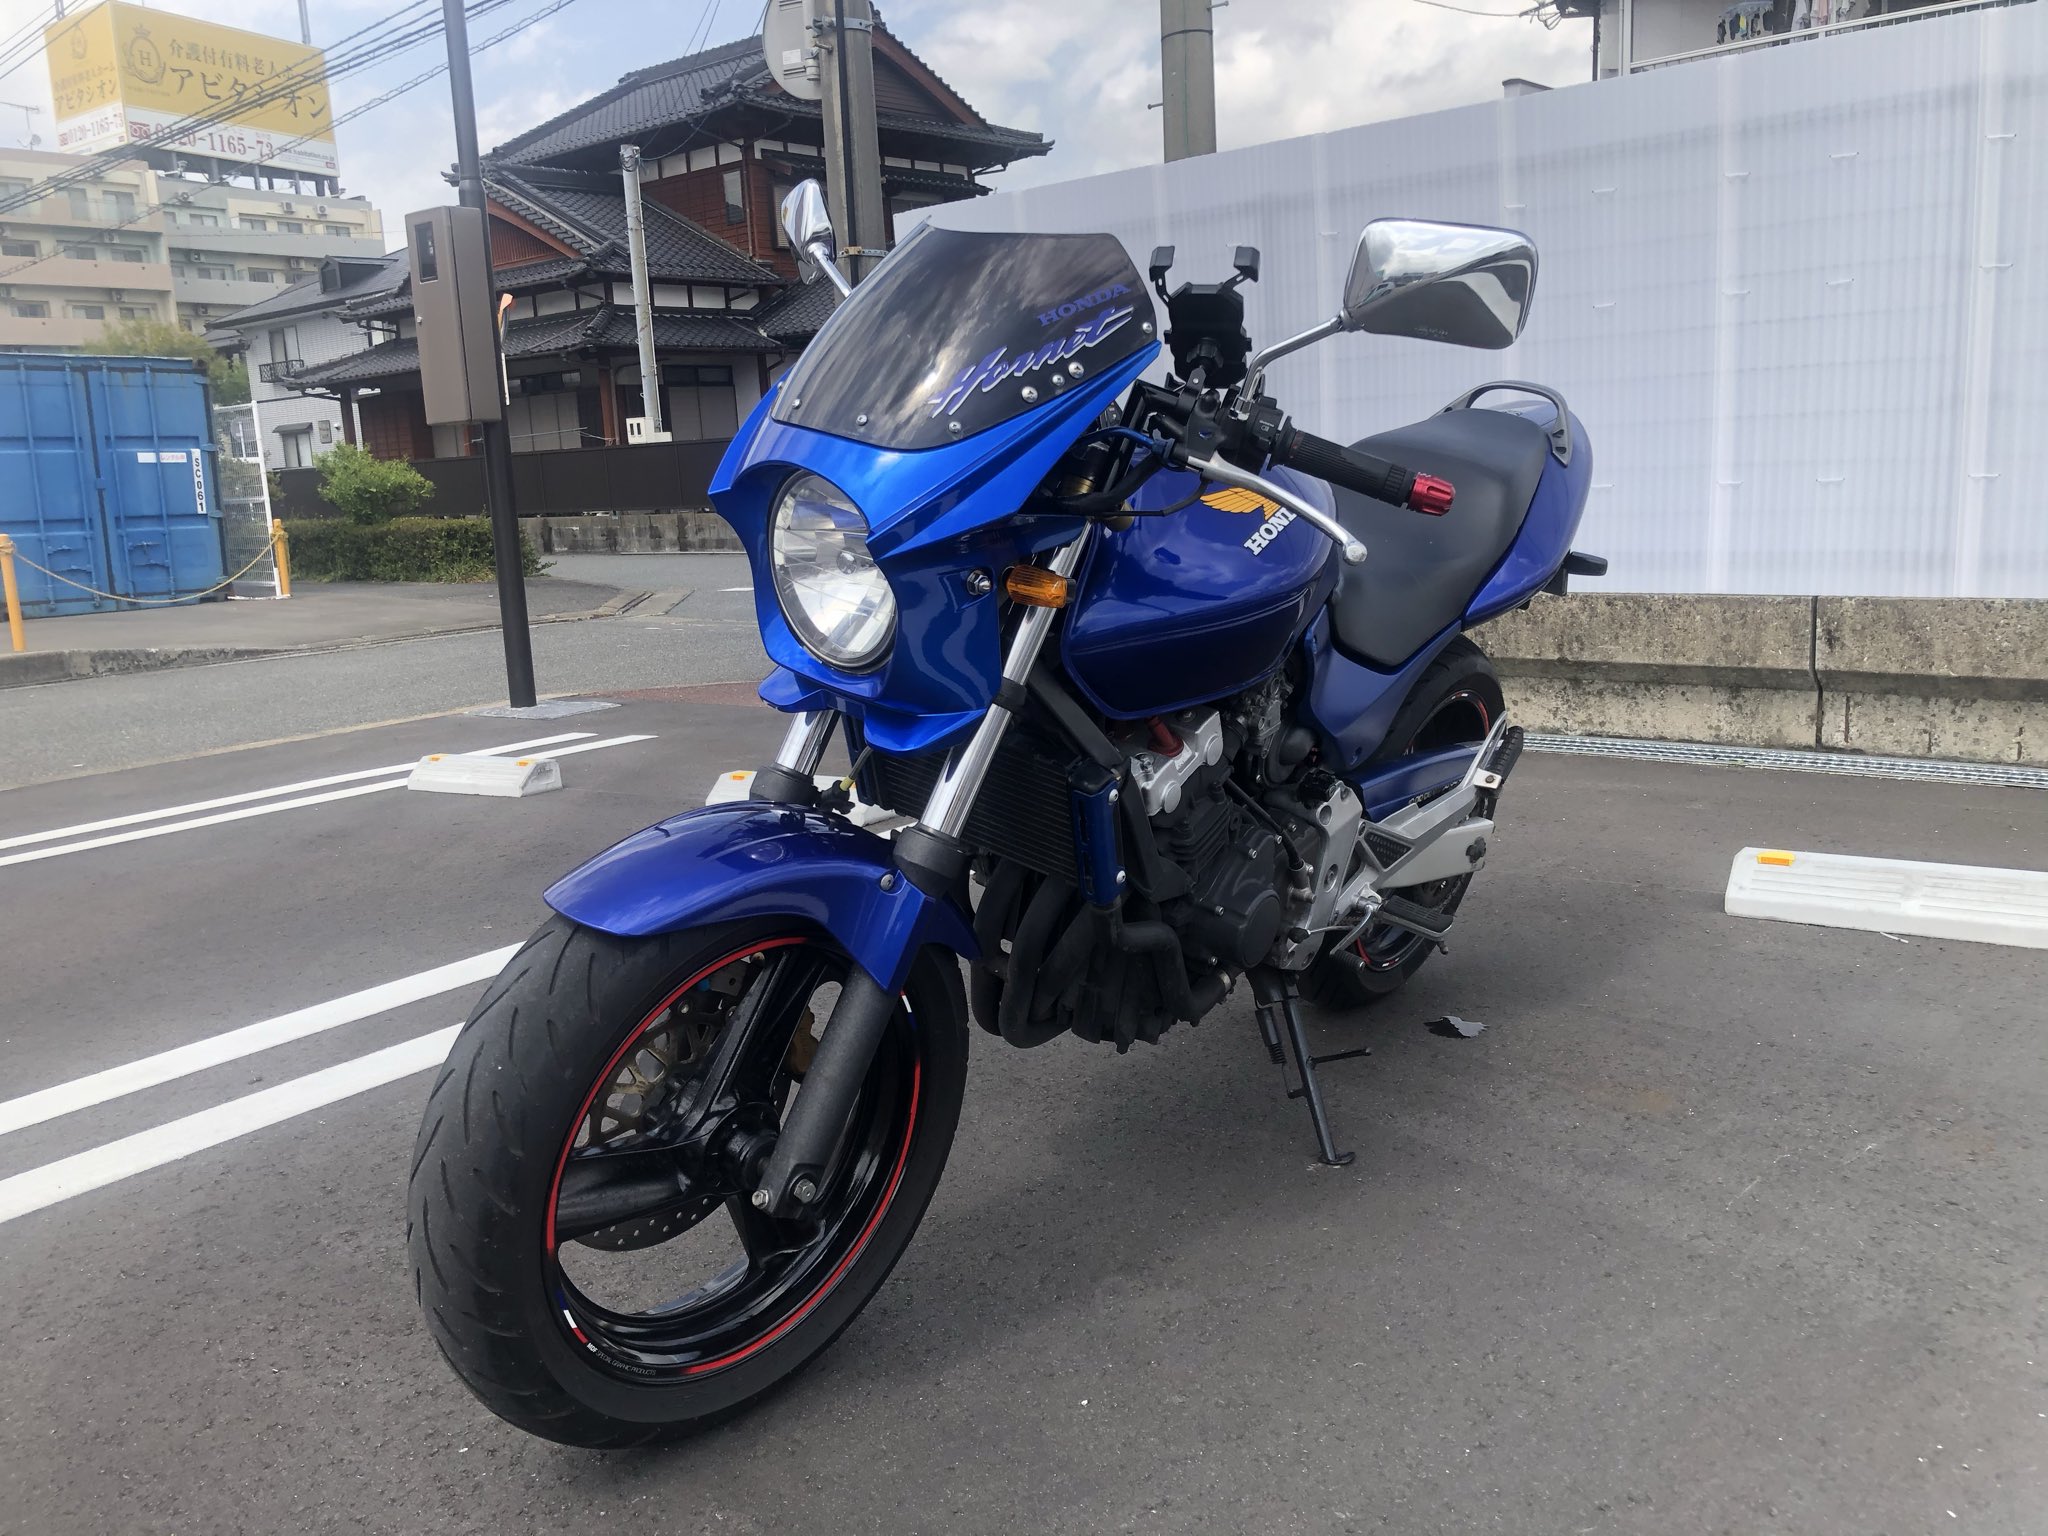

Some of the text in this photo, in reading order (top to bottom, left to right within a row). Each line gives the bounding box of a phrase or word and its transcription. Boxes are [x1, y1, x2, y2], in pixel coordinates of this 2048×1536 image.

[1038, 283, 1131, 327] HONDA
[927, 304, 1135, 418] Hornet
[194, 457, 205, 512] SC061
[1243, 507, 1297, 556] HON
